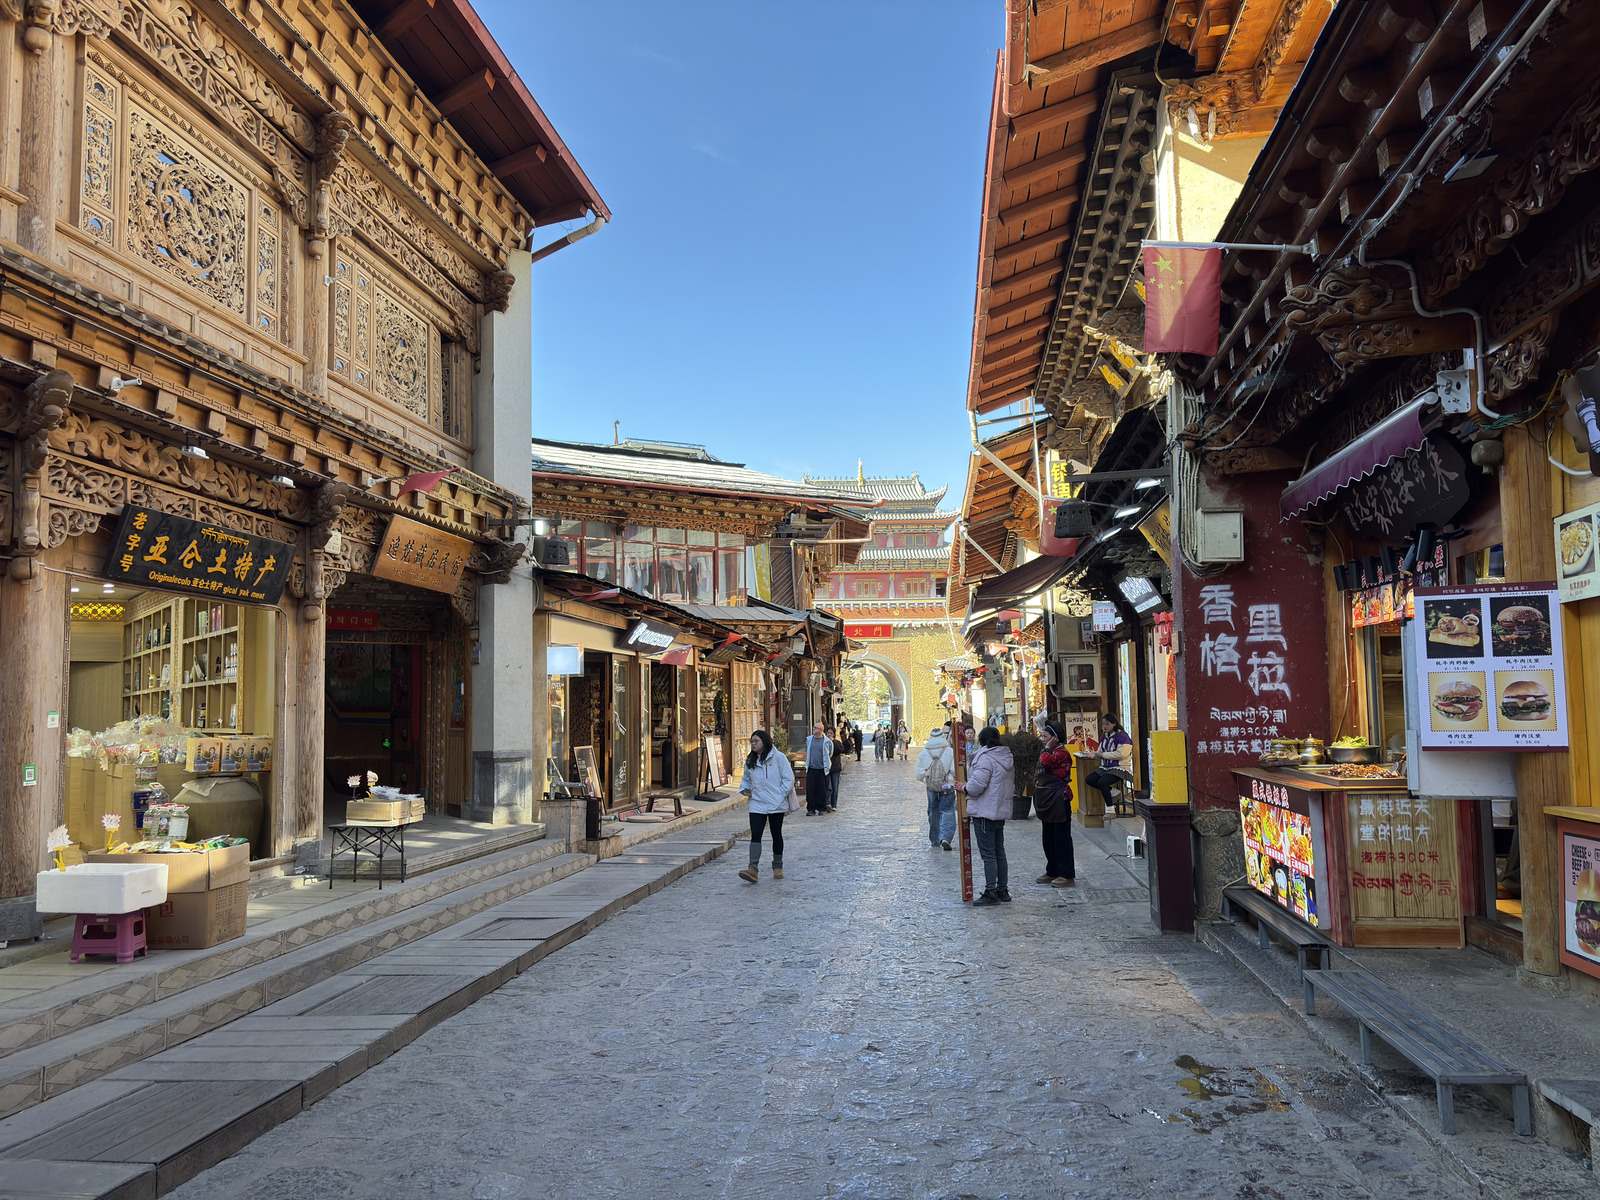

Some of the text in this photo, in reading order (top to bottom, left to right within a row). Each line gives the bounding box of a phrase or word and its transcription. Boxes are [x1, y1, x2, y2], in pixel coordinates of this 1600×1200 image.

[119, 512, 148, 573] 老字号
[143, 535, 277, 587] 亚仑土特产
[148, 570, 266, 600] Originalecolo 亚仑土特产 gical yak meat
[854, 626, 882, 637] 北門
[1198, 584, 1242, 682] 香格
[1245, 603, 1291, 701] 里拉
[1360, 823, 1431, 846] 堂的地方
[1572, 844, 1586, 860] CHEESE
[1572, 857, 1582, 870] BEEF
